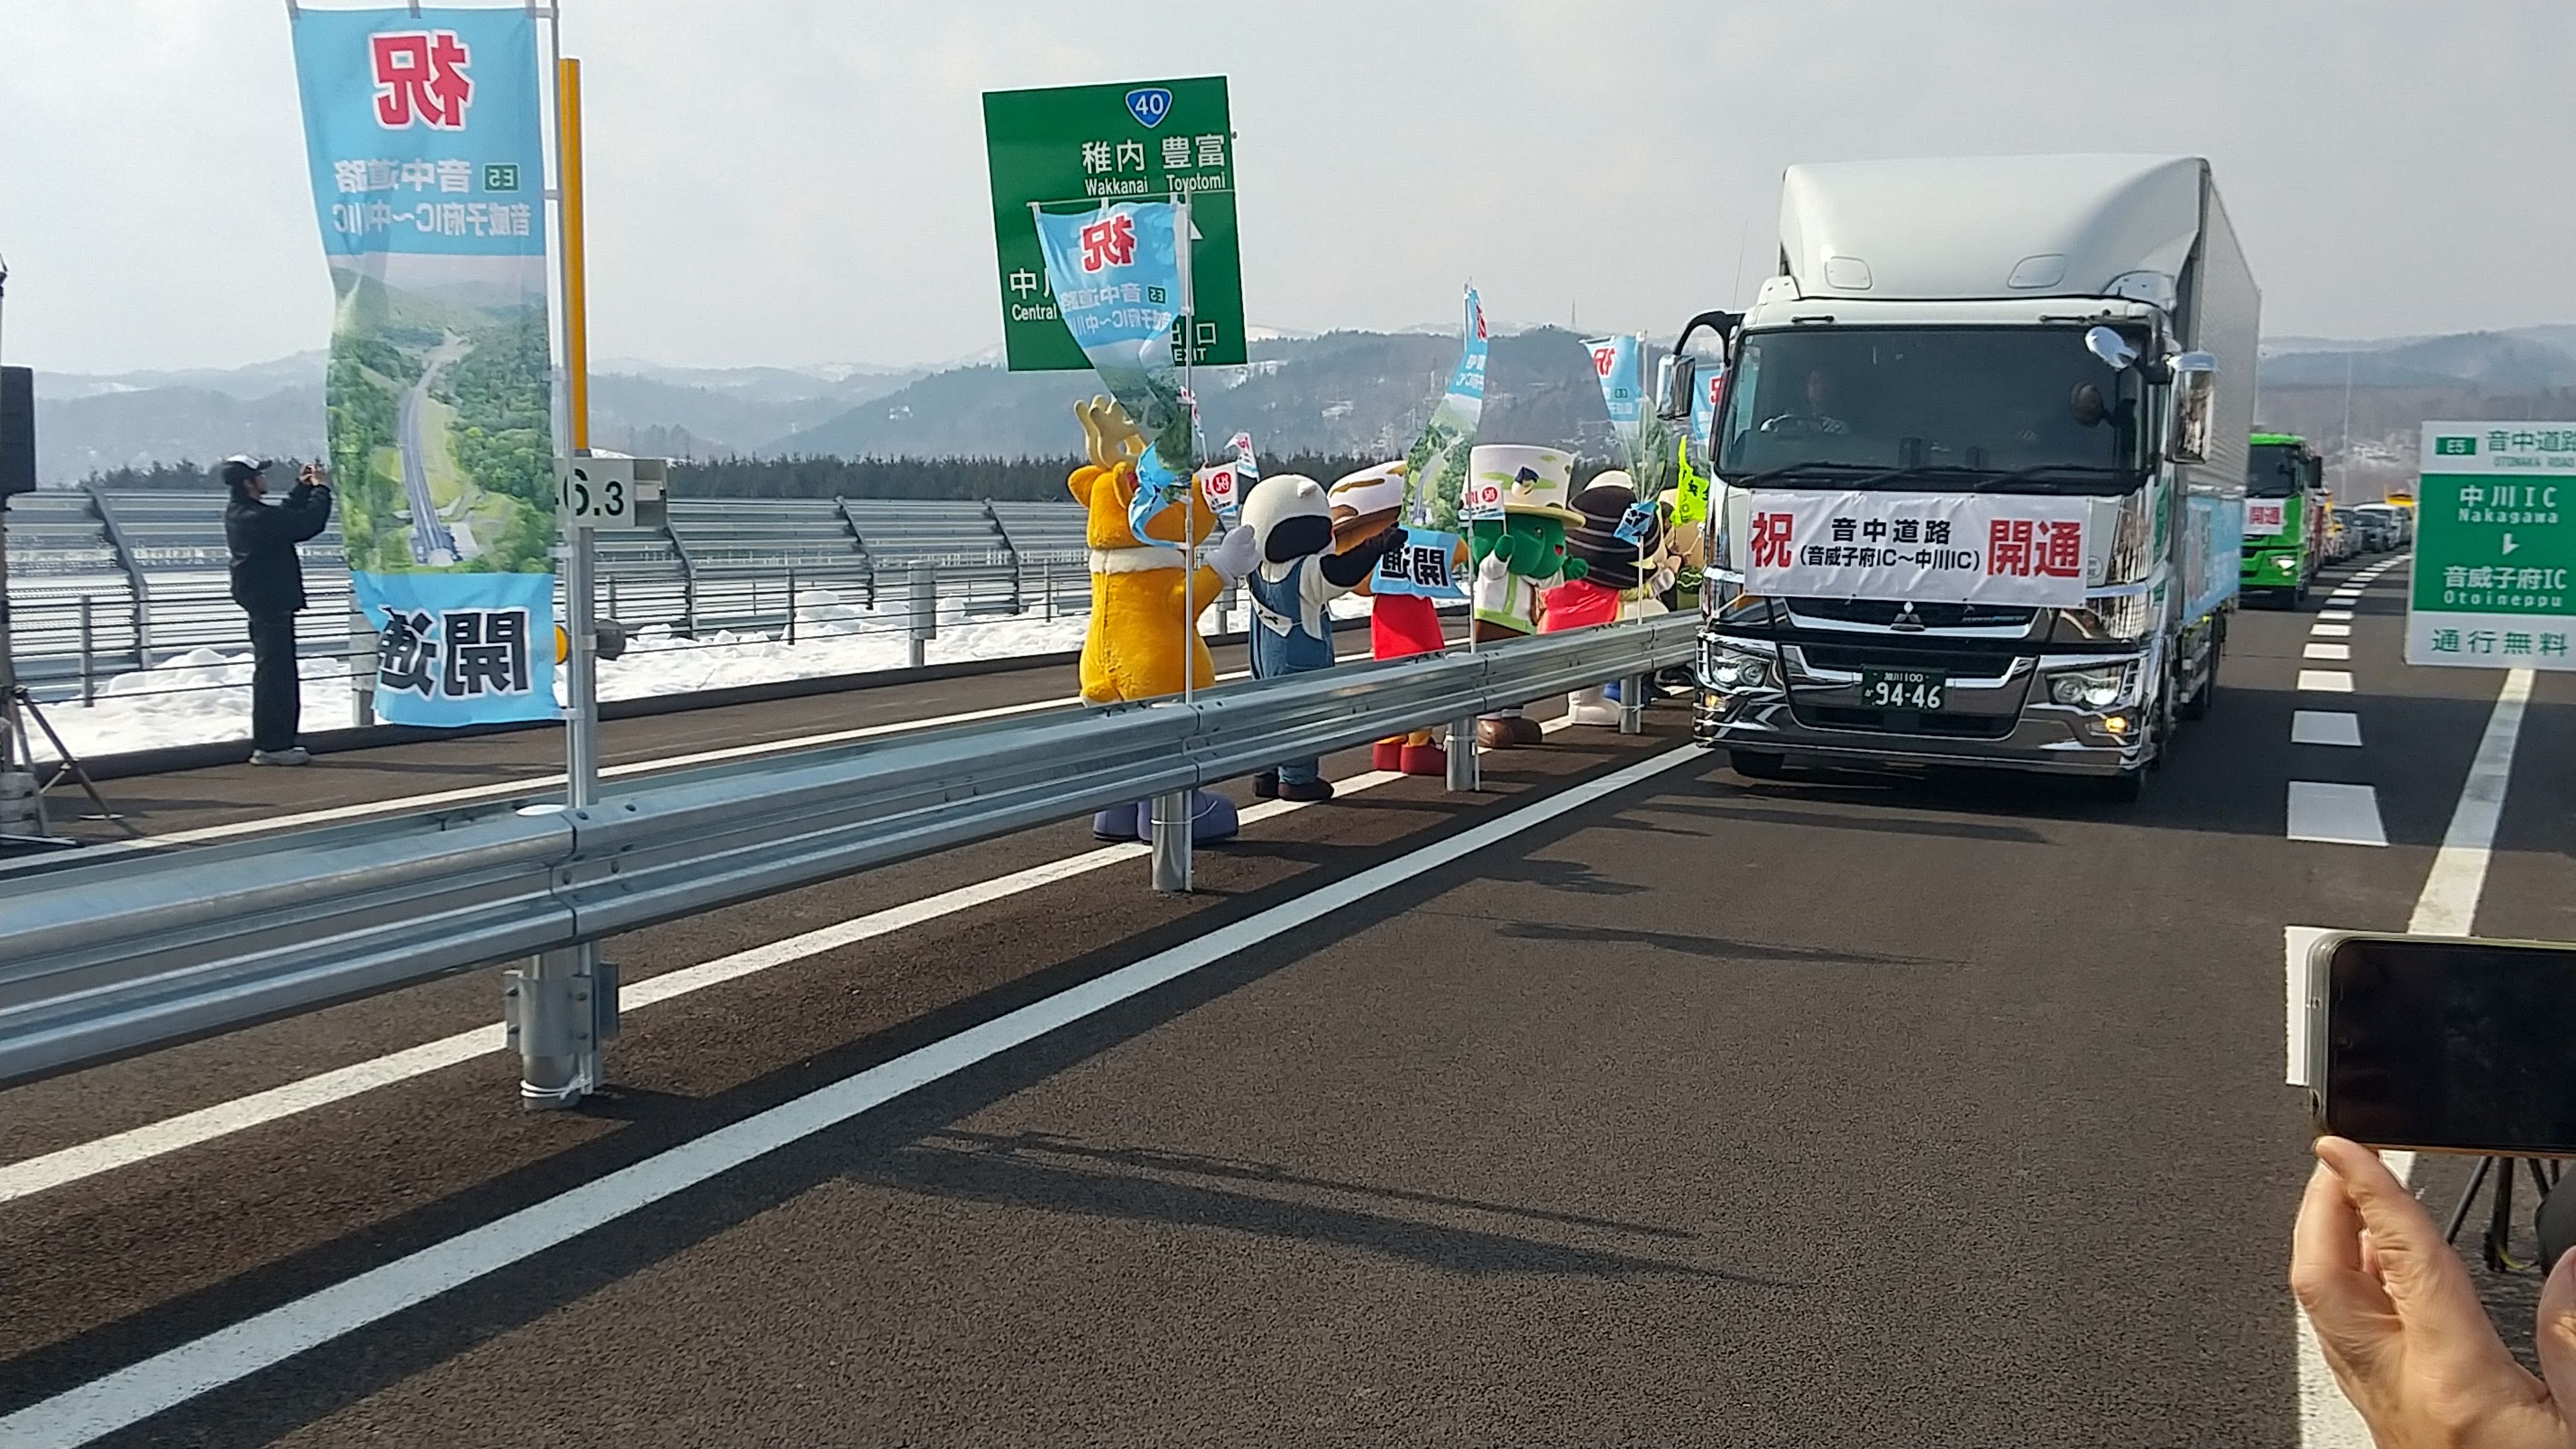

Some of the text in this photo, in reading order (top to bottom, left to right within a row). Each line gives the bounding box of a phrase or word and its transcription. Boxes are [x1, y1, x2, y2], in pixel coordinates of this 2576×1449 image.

[1135, 94, 1165, 115] 40
[1082, 133, 1225, 174] 稚内 豊富
[1085, 171, 1226, 196] Wakkanai Toyotomi
[1012, 303, 1058, 321] Central
[2447, 439, 2466, 453] E5
[2459, 484, 2559, 508] 中川IC
[2458, 508, 2559, 524] Nakagawa
[1750, 512, 1794, 568] 祝
[1831, 517, 1953, 545] 音中道路
[1986, 519, 2082, 578] 開通
[2443, 566, 2568, 590] 音威子府IC
[2444, 590, 2563, 608] Otoineppu
[2431, 629, 2569, 657] 通行無料
[1905, 672, 1923, 682] 100
[1876, 682, 1942, 709] 94-46
